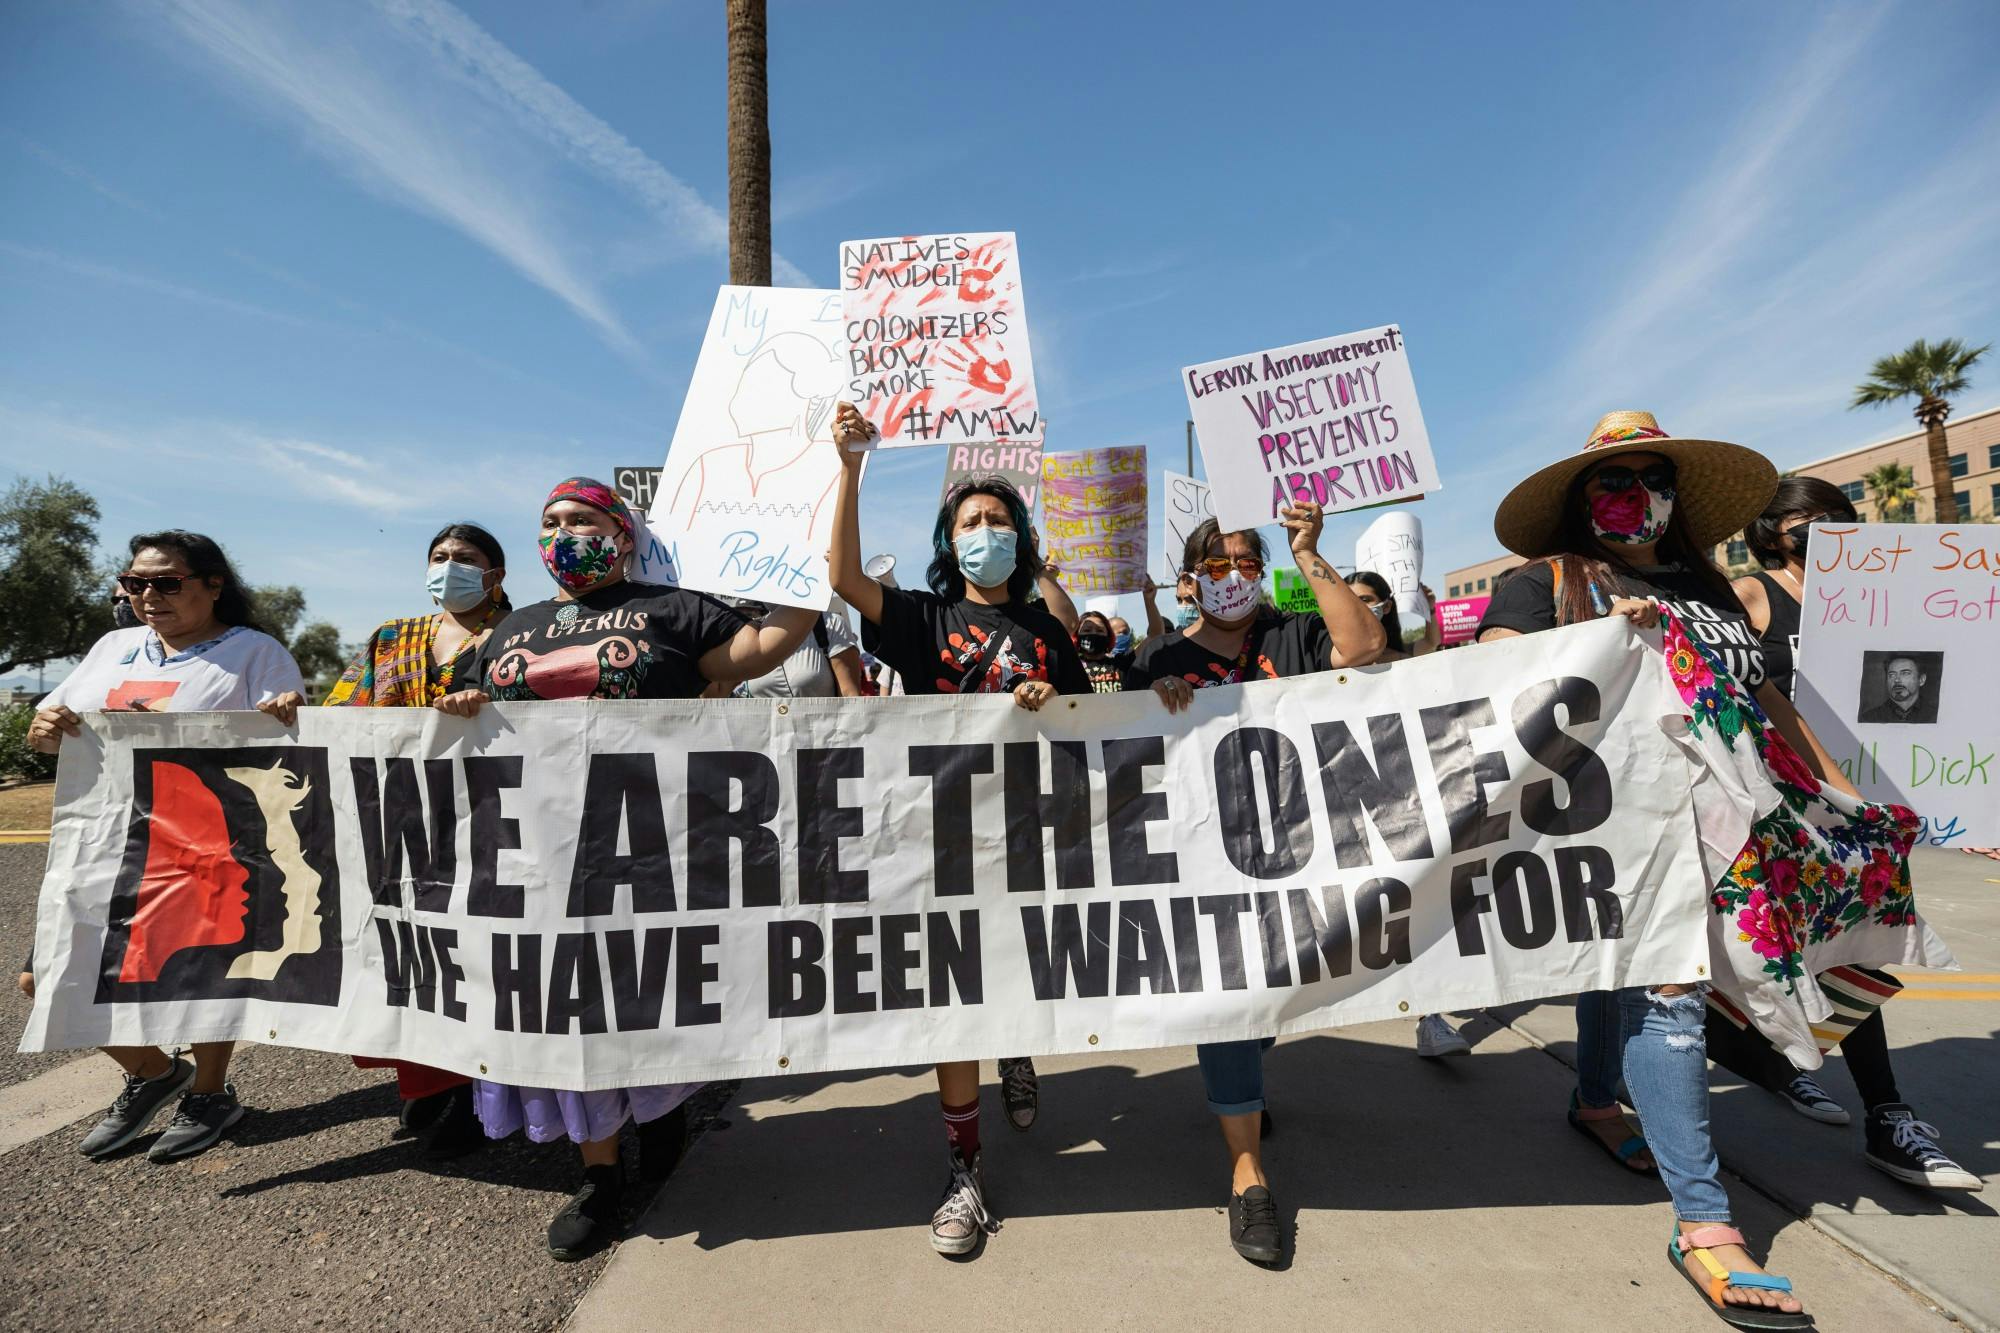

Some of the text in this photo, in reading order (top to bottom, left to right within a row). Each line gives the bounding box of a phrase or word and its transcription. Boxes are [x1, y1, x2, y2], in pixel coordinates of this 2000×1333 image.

[844, 237, 970, 267] NATIVES
[845, 263, 965, 291] SMUDGE
[722, 289, 768, 356] My
[846, 311, 1008, 343] COLONIZERS
[849, 345, 928, 377] BLOW
[850, 369, 936, 402] SMOKE
[1189, 369, 1258, 398] CERVIX
[1241, 361, 1381, 430] VASECTOMY
[902, 405, 1038, 441] #MMIW
[1258, 405, 1399, 472] PREVENTS
[952, 446, 1042, 475] RIGHTS
[1272, 450, 1419, 519] ABORTION
[639, 531, 819, 598] My Rights
[1816, 528, 1913, 573] Just
[1225, 581, 1242, 600] girl
[1291, 587, 1309, 600] ARE
[1818, 586, 1889, 627] Ya'll
[1442, 611, 1463, 619] WITH
[1443, 616, 1478, 626] PLANNED
[1446, 603, 1470, 612] STAND
[1912, 741, 1995, 788] Dick
[350, 676, 1613, 919] WE ARE THE ONES
[375, 845, 1624, 1034] WE HAVE BEEN WAITING FOR
